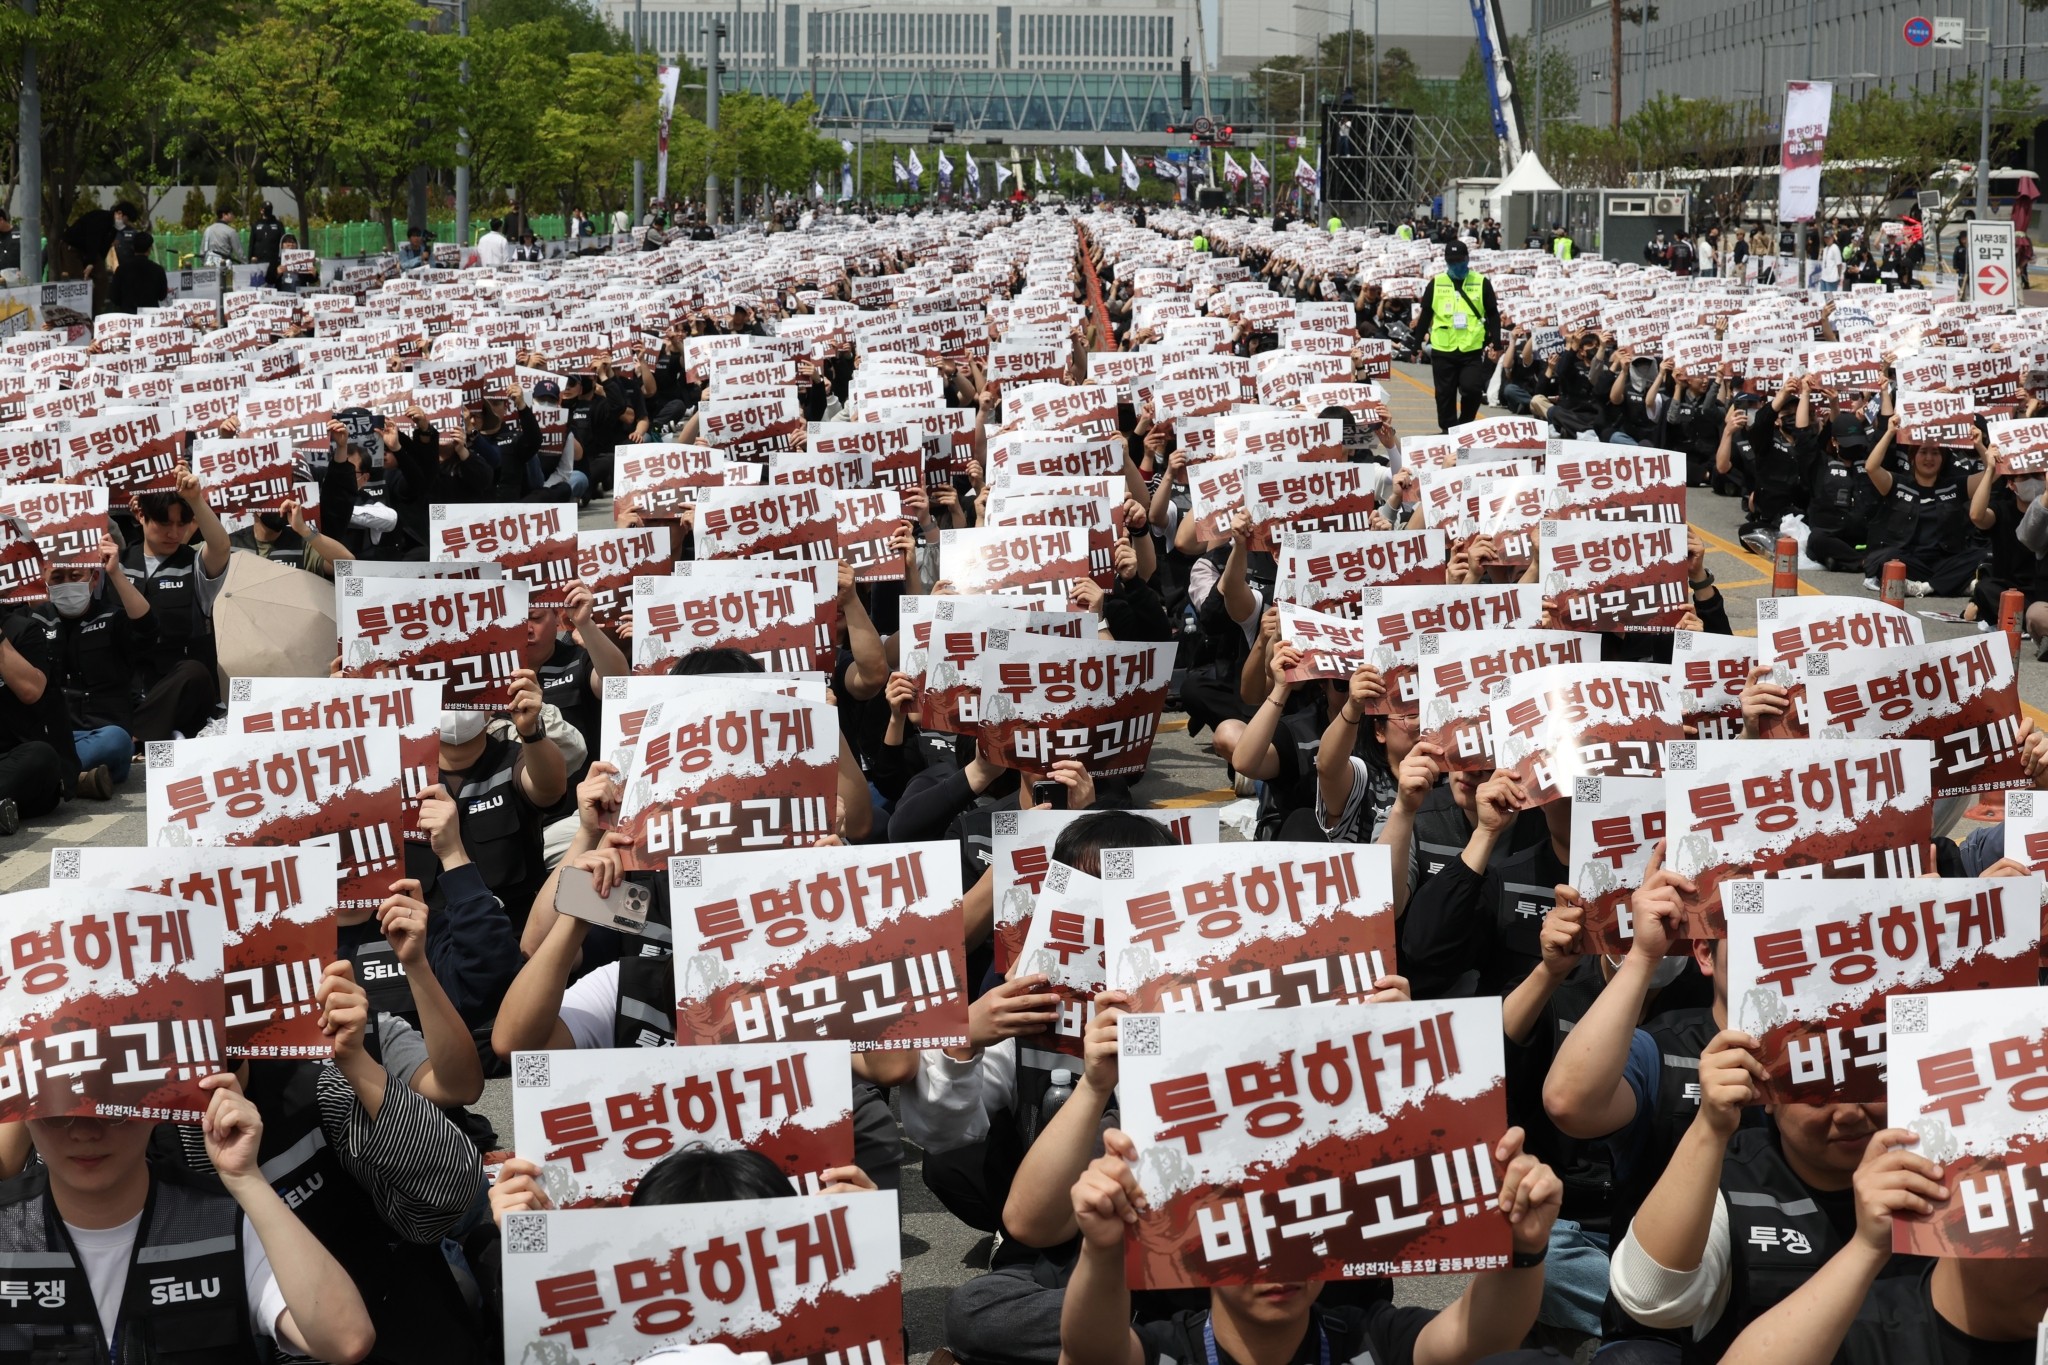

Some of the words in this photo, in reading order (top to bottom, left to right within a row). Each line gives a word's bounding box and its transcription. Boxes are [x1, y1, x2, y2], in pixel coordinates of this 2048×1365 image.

[1787, 123, 1823, 139] 투명하게
[1974, 232, 2008, 245] 사무3동
[1978, 246, 2005, 261] 입구
[855, 278, 890, 293] 투명하게
[912, 299, 951, 315] 투명하게
[1013, 303, 1060, 319] 투명하게
[1249, 300, 1290, 315] 투명하게
[1561, 299, 1600, 318] 투명하게
[1605, 305, 1646, 327] 투명하게
[98, 316, 144, 334] 투명하게
[318, 314, 359, 331] 투명하게
[474, 320, 520, 337] 투명하게
[1628, 321, 1670, 337] 투명하게
[135, 327, 185, 350] 투명하게
[540, 333, 590, 353] 투명하게
[1291, 336, 1344, 353] 투명하게
[1679, 343, 1722, 359] 투명하게
[31, 352, 79, 371] 투명하게
[309, 344, 359, 363] 투명하게
[994, 350, 1056, 373] 투명하게
[1094, 354, 1154, 377] 투명하게
[1814, 346, 1873, 365] 투명하게
[1952, 355, 2012, 380] 투명하게
[421, 363, 477, 388] 투명하게
[1821, 368, 1879, 387] 바꾸고!!!
[245, 391, 322, 420] 투명하게
[1032, 388, 1107, 422] 투명하게
[1161, 381, 1231, 409] 투명하게
[1307, 386, 1372, 408] 투명하게
[1903, 396, 1966, 419] 투명하게
[706, 400, 784, 435] 투명하게
[1911, 422, 1971, 441] 바꾸고!!!
[68, 413, 161, 461] 투명하게
[1245, 421, 1331, 454] 투명하게
[1458, 421, 1538, 448] 투명하게
[199, 441, 280, 477] 투명하게
[623, 450, 713, 482] 투명하게
[1556, 454, 1672, 492] 투명하게
[208, 476, 290, 507] 바꾸고!!!
[1258, 467, 1361, 508] 투명하게
[705, 488, 821, 540] 투명하게
[441, 507, 560, 558] 투명하게
[980, 530, 1072, 572] 명하게
[1307, 534, 1429, 588] 투명하게
[1551, 527, 1674, 578] 투명하게
[159, 580, 184, 590] SELU
[357, 585, 507, 645] 투명하게
[647, 586, 796, 642] 투명하게
[1568, 581, 1684, 622] 바꾸고!!!
[1377, 588, 1523, 652] 투명하게
[1773, 613, 1915, 669] 투명하게
[998, 647, 1157, 703] 투명하게
[1824, 639, 1996, 733] 투명하게
[1505, 677, 1667, 740] 투명하게
[641, 707, 814, 784] 투명하게
[1014, 712, 1155, 764] 바꾸고!!!
[166, 735, 370, 830] 투명하게
[1687, 747, 1906, 842] 투명하게
[1937, 784, 1992, 797] 삼성전자노동조합
[1992, 778, 2034, 791] 공동투쟁본부
[467, 794, 504, 815] SELU
[646, 796, 829, 855] 바꾸고!!!
[694, 851, 929, 961] 투명하게
[1126, 852, 1361, 953] 투명하게
[0, 909, 195, 995] 명하게
[1753, 886, 2006, 997] 투명하게
[731, 949, 960, 1042] 바꾸고!!!
[280, 1044, 333, 1058] 공동투쟁본부
[913, 1035, 968, 1049] 공동투쟁본부
[1150, 1011, 1462, 1156] 투명하게
[95, 1103, 170, 1121] 삼성전자노동조합
[541, 1053, 813, 1173] 투명하게
[1197, 1142, 1501, 1269] 바꾸고!!!
[1748, 1225, 1813, 1255] 투쟁
[536, 1206, 856, 1350] 투명하게
[1341, 1257, 1437, 1277] 삼성전자노동조합
[1439, 1254, 1510, 1272] 공동투쟁본부
[0, 1279, 67, 1308] 투쟁
[150, 1277, 221, 1306] SELU
